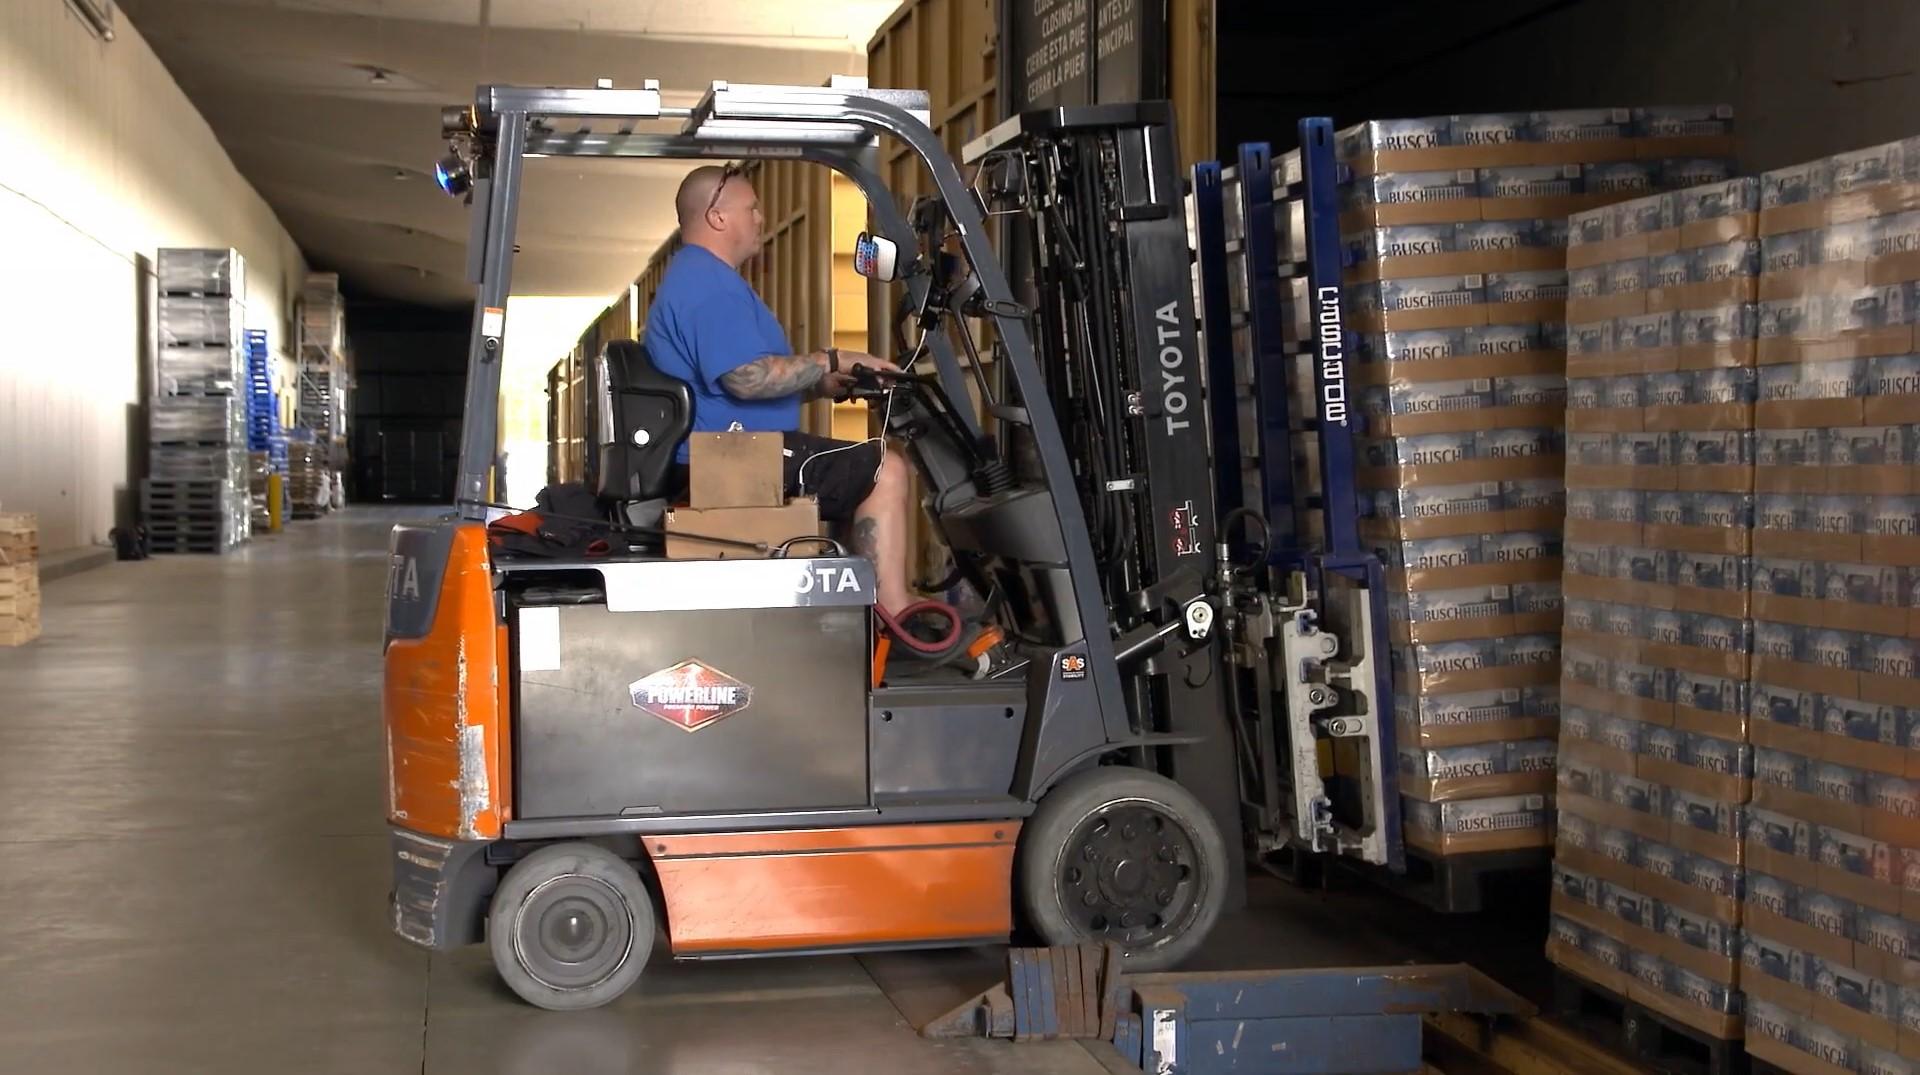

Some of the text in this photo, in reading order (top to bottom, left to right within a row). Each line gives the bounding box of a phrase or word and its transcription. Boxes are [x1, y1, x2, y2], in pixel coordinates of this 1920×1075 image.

[1049, 33, 1068, 61] ESTA
[1052, 64, 1063, 87] LA
[1155, 300, 1190, 436] TOYOTA
[1062, 656, 1085, 671] SAS
[647, 686, 737, 705] POWERLINE
